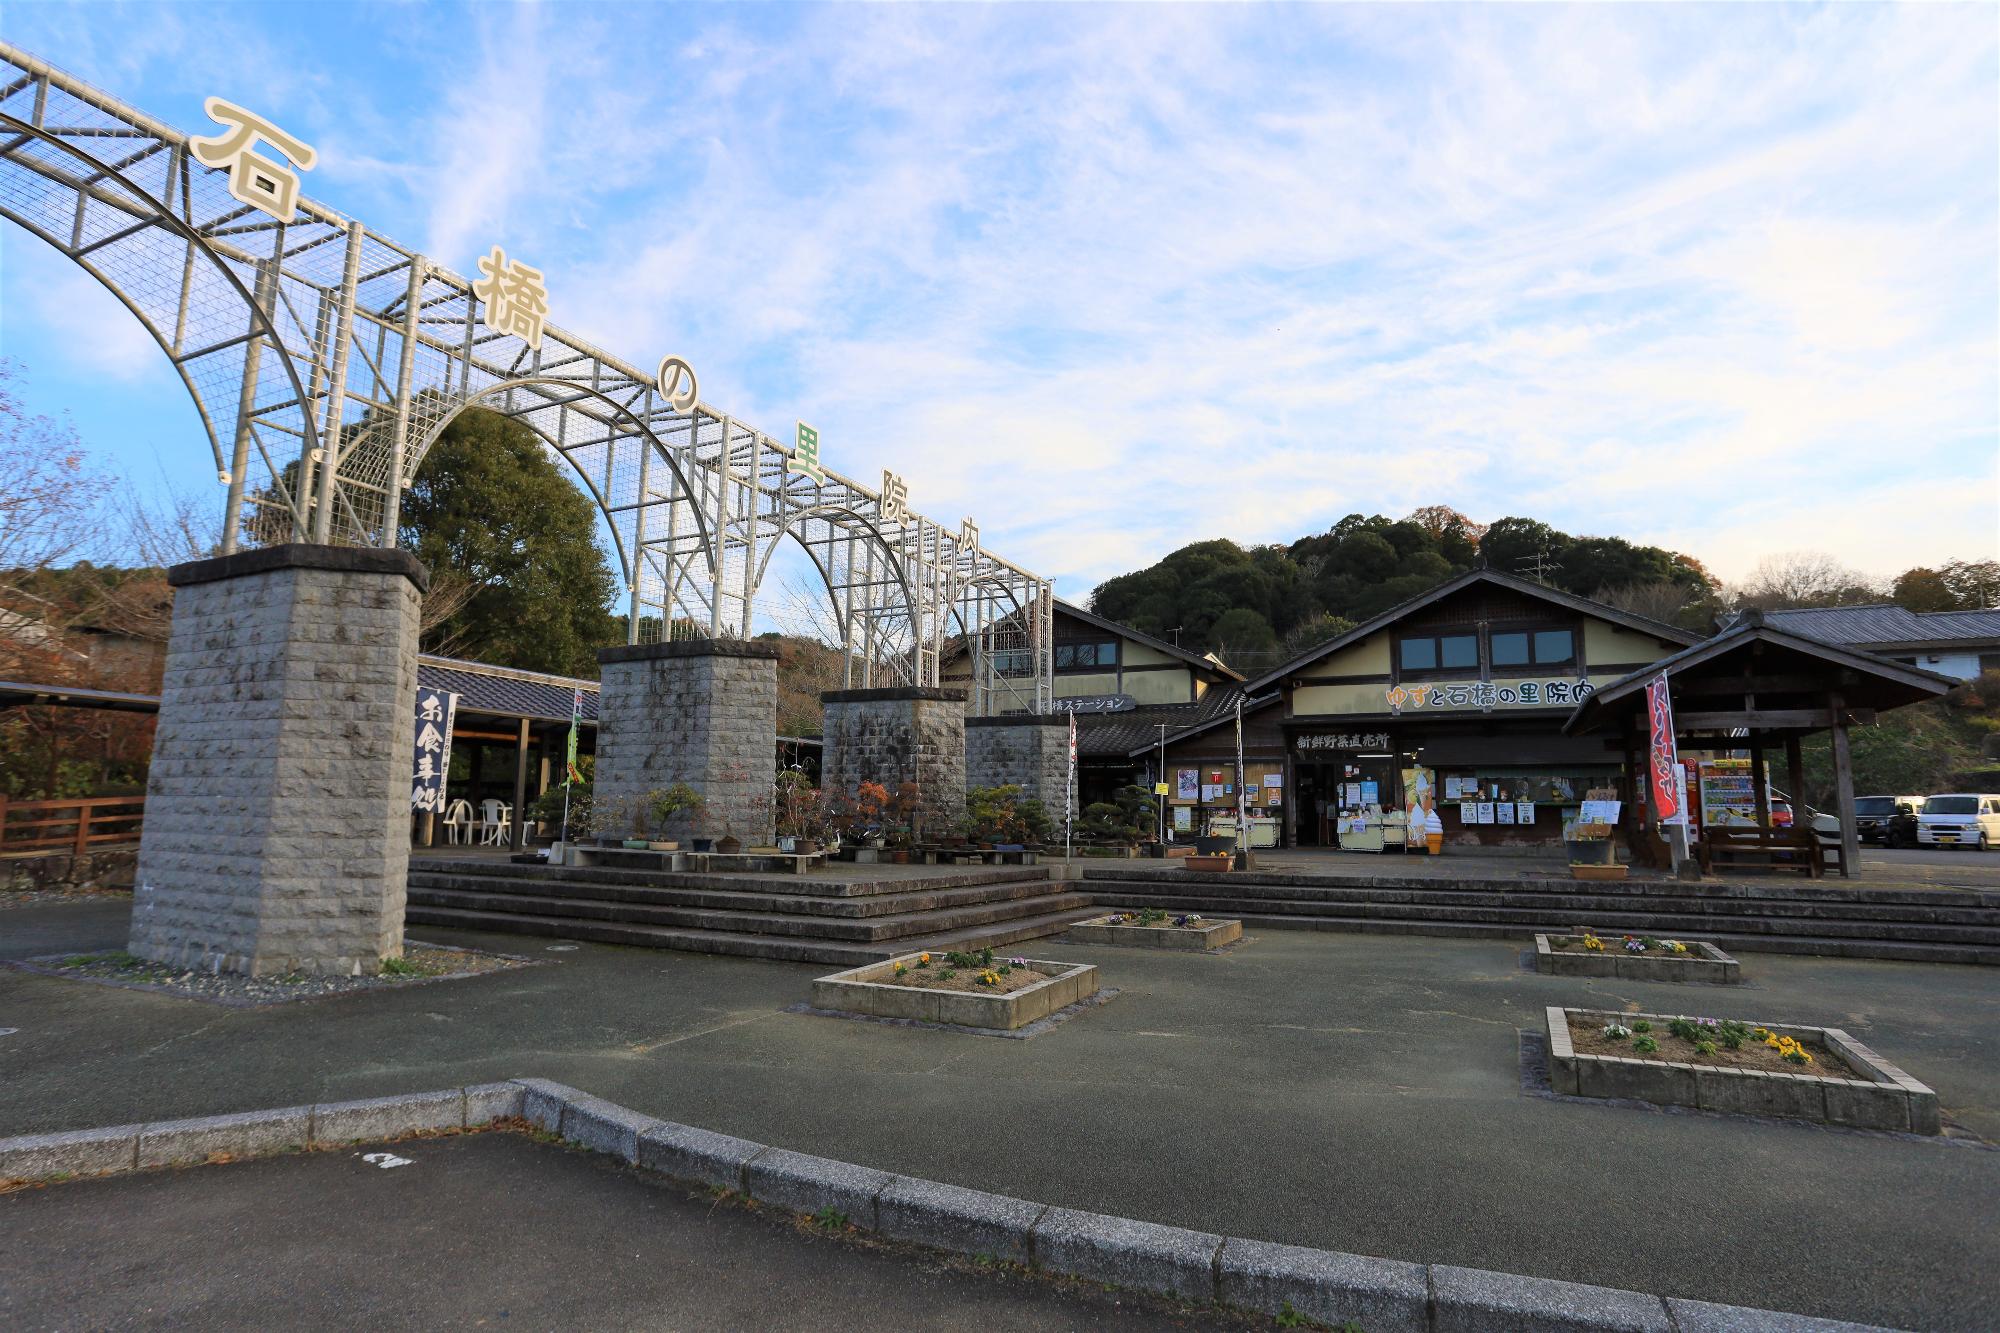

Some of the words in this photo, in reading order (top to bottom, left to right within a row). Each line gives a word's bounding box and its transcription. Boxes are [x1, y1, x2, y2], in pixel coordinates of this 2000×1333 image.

[411, 694, 445, 812] お食事処
[1296, 732, 1390, 749] 新鮮野菜直売所
